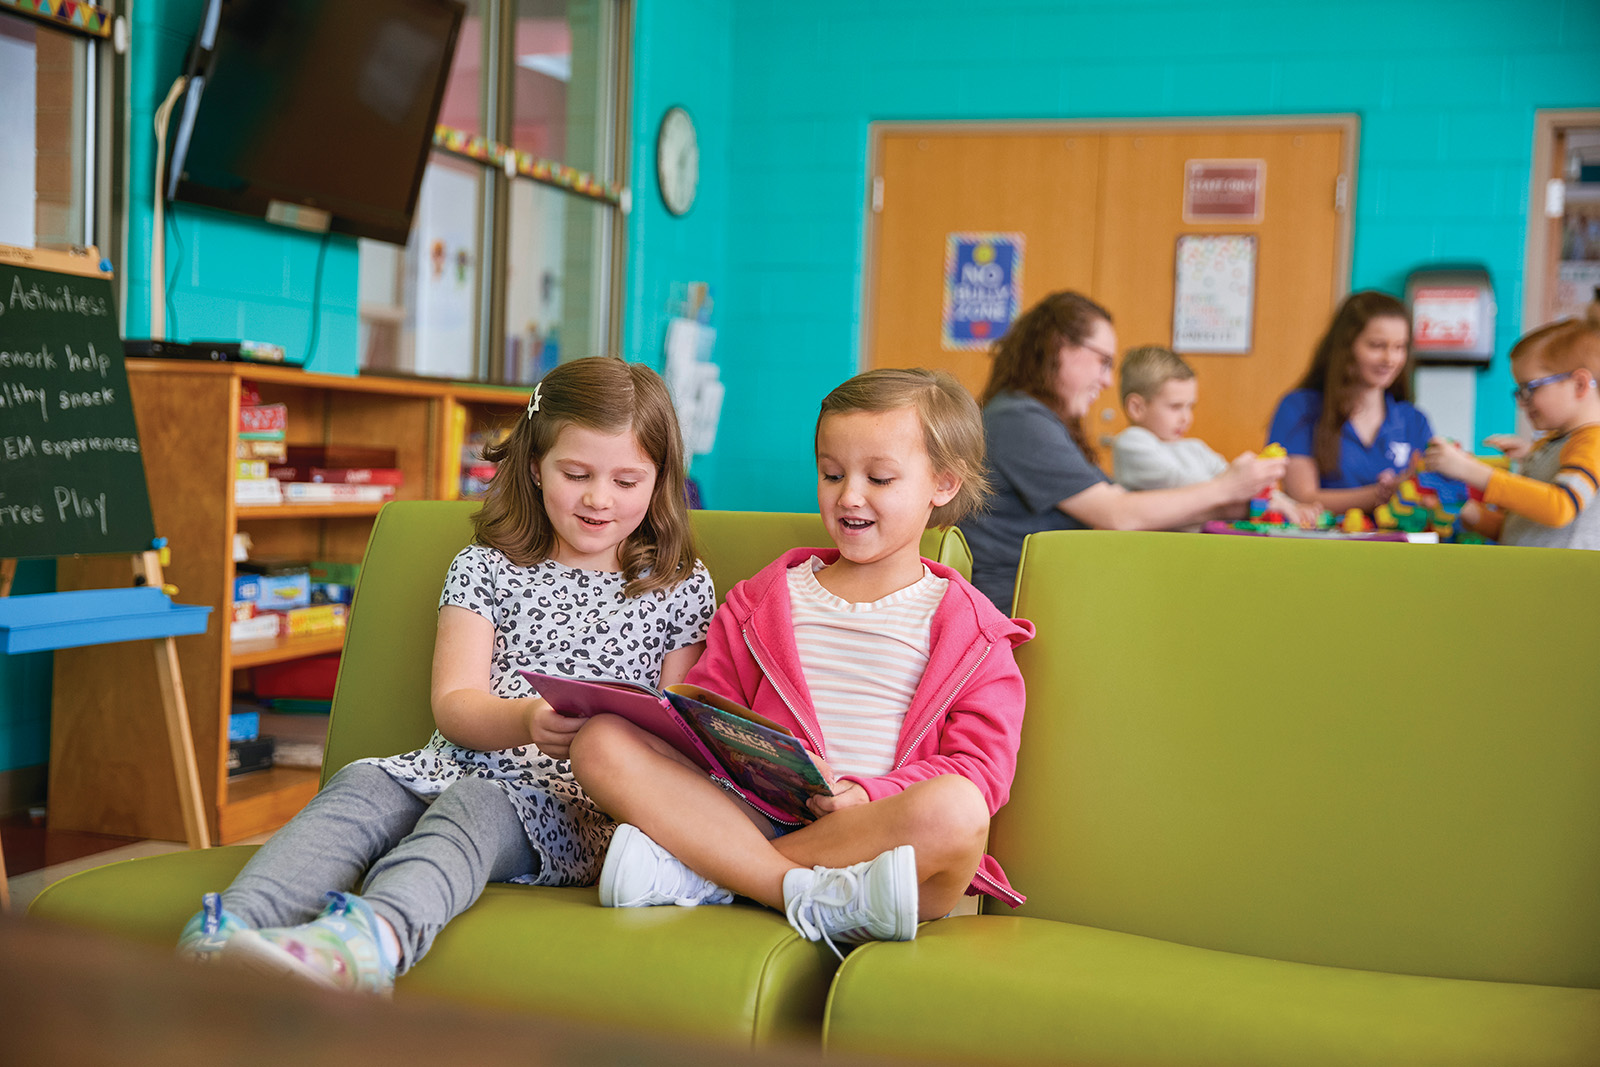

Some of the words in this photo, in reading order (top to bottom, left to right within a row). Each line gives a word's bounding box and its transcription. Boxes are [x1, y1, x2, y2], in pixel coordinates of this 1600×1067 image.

[961, 262, 1004, 288] NO
[64, 341, 111, 378] help
[59, 386, 115, 410] snack
[3, 435, 37, 460] EM
[41, 437, 140, 461] experiences
[53, 485, 108, 536] Play
[709, 719, 777, 753] ALICE
